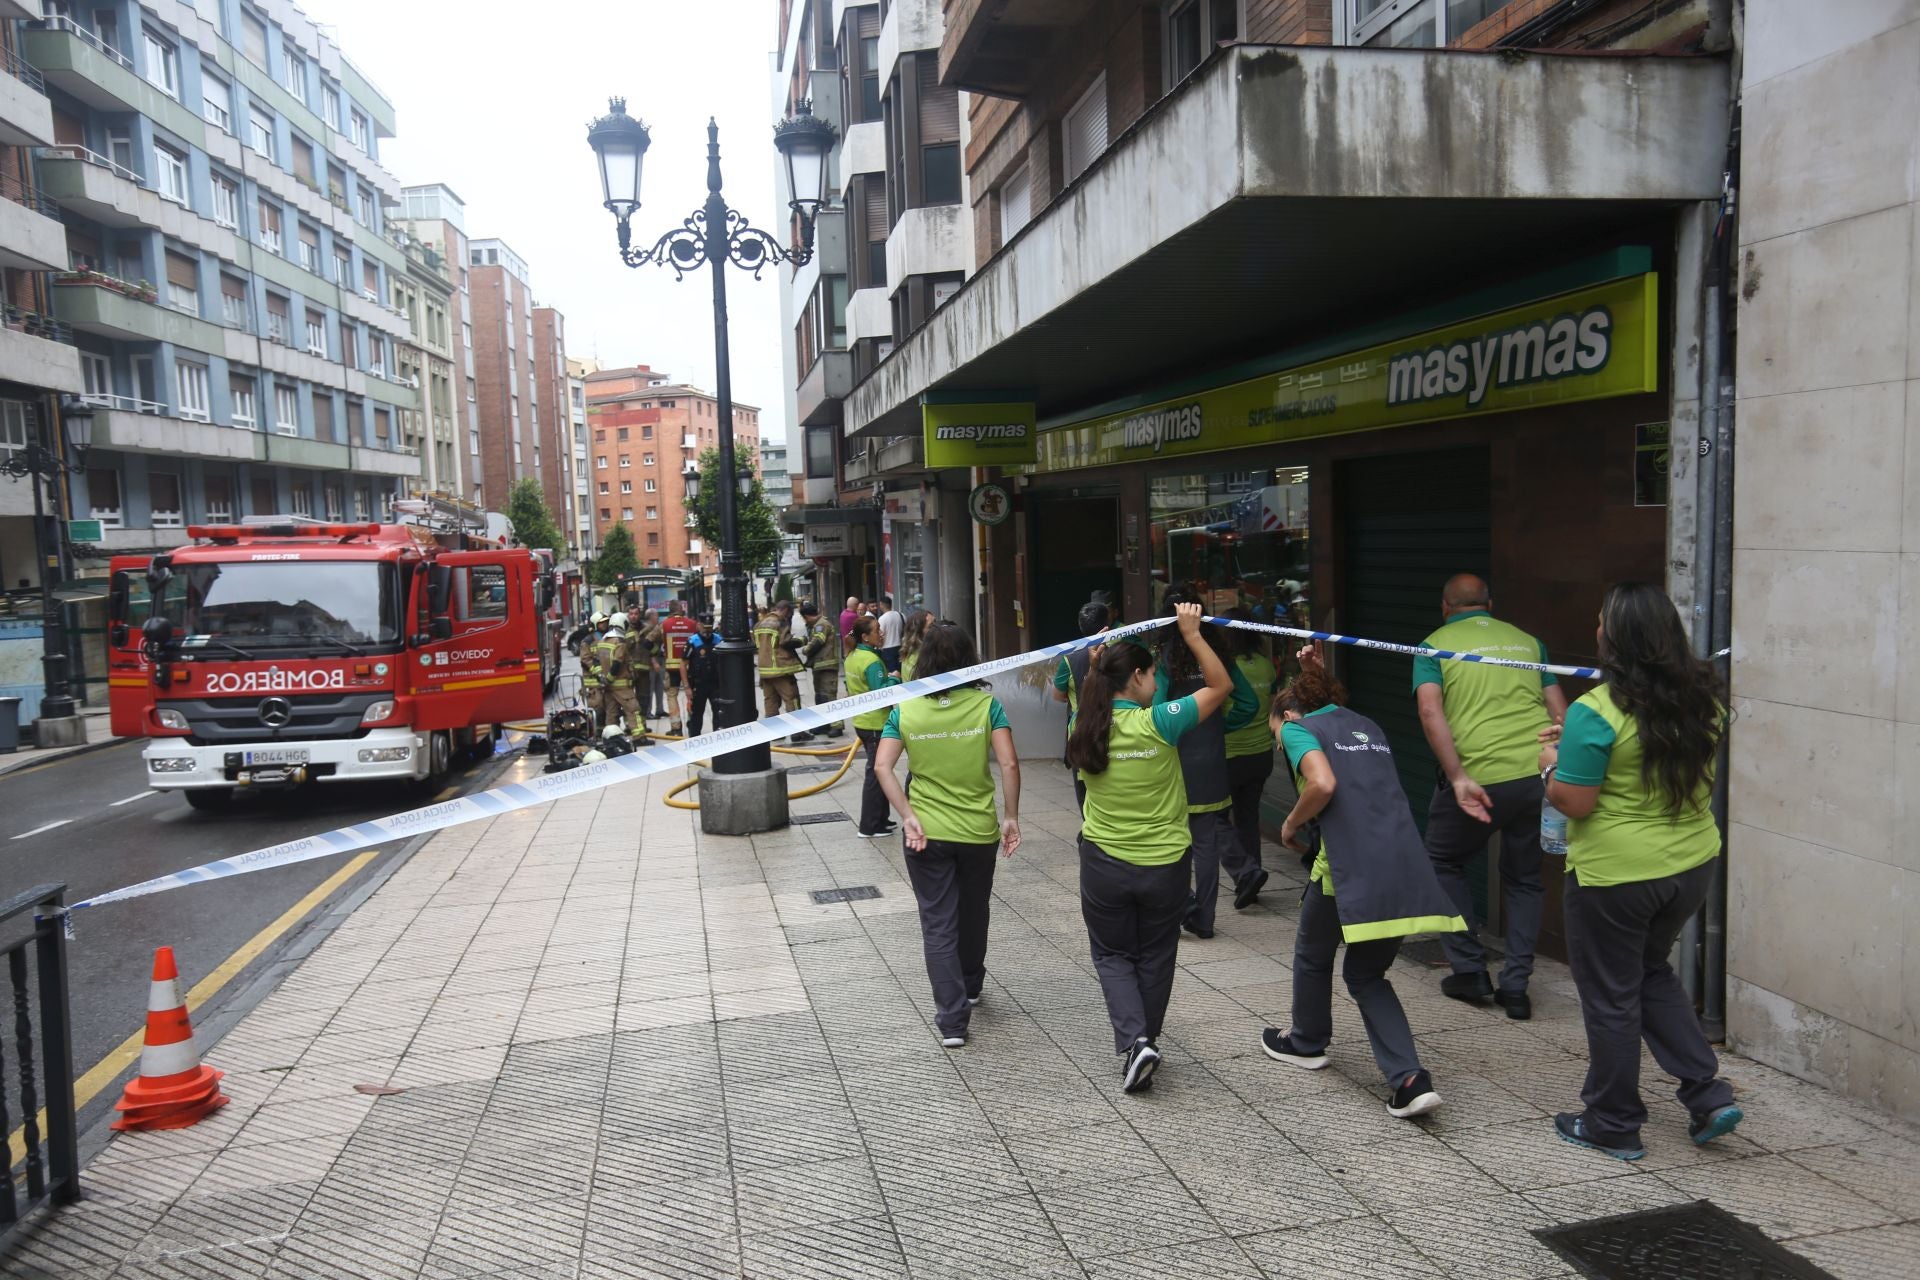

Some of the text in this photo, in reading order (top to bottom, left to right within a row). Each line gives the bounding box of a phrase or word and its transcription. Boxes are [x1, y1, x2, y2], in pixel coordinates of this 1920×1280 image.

[1388, 310, 1610, 405] masymas
[936, 423, 1027, 441] masymas
[1124, 403, 1201, 450] masymas
[451, 649, 490, 660] OVIEDO
[909, 727, 985, 740] Queremos ayudarte!
[254, 750, 308, 763] 8044 HGC
[1116, 746, 1157, 760] ayudarte!
